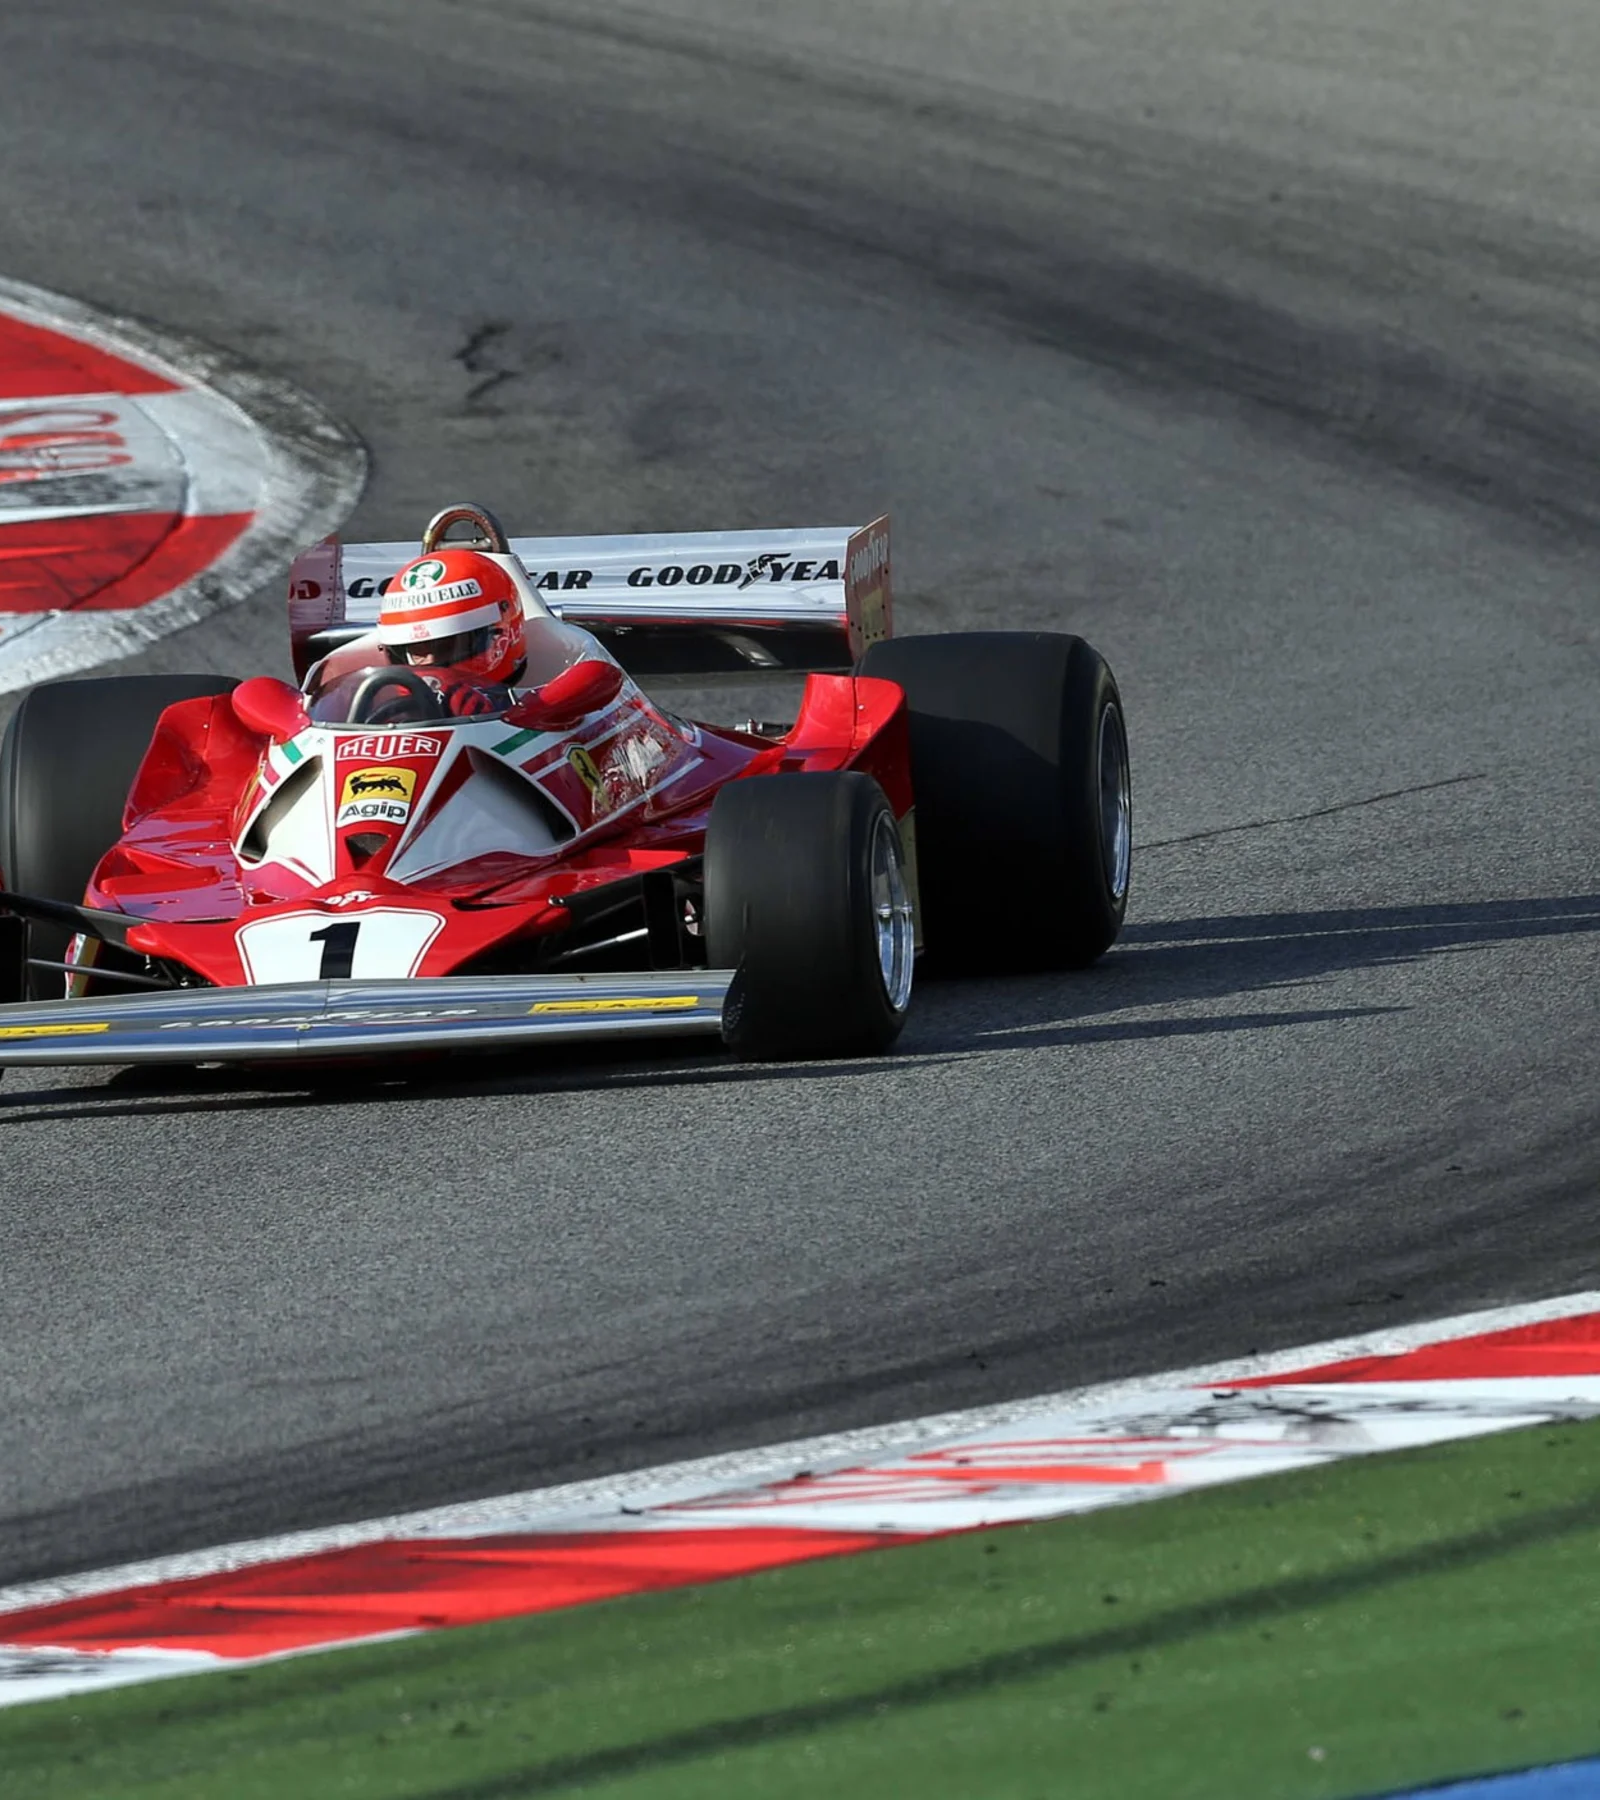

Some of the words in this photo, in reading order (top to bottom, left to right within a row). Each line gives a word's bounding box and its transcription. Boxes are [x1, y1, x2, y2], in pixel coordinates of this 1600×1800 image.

[627, 559, 846, 588] GOODYEA
[343, 736, 433, 758] HEUER
[340, 802, 407, 821] Agip
[309, 921, 361, 979] 1
